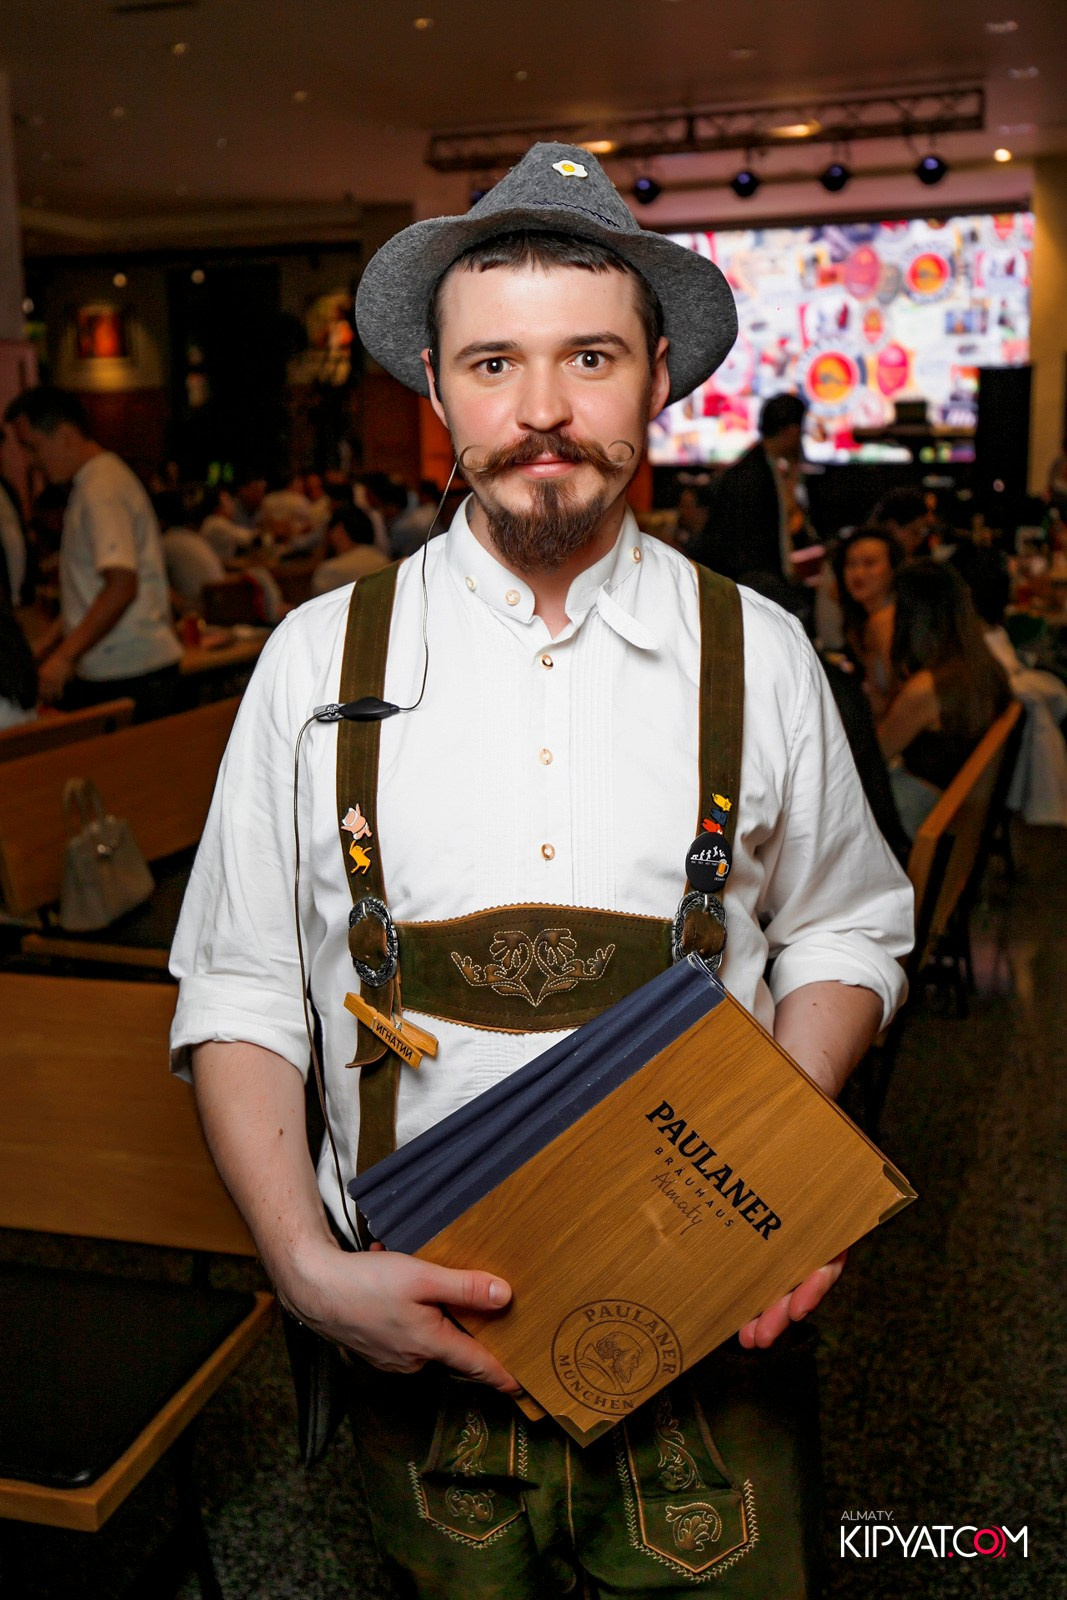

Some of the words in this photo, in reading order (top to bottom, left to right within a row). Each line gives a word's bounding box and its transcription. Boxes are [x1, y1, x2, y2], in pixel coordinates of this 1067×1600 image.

[645, 1100, 782, 1241] PAULANER
[651, 1171, 703, 1236] Almaty
[583, 1305, 677, 1375] PAULANER
[558, 1354, 634, 1409] MÜNCHEN
